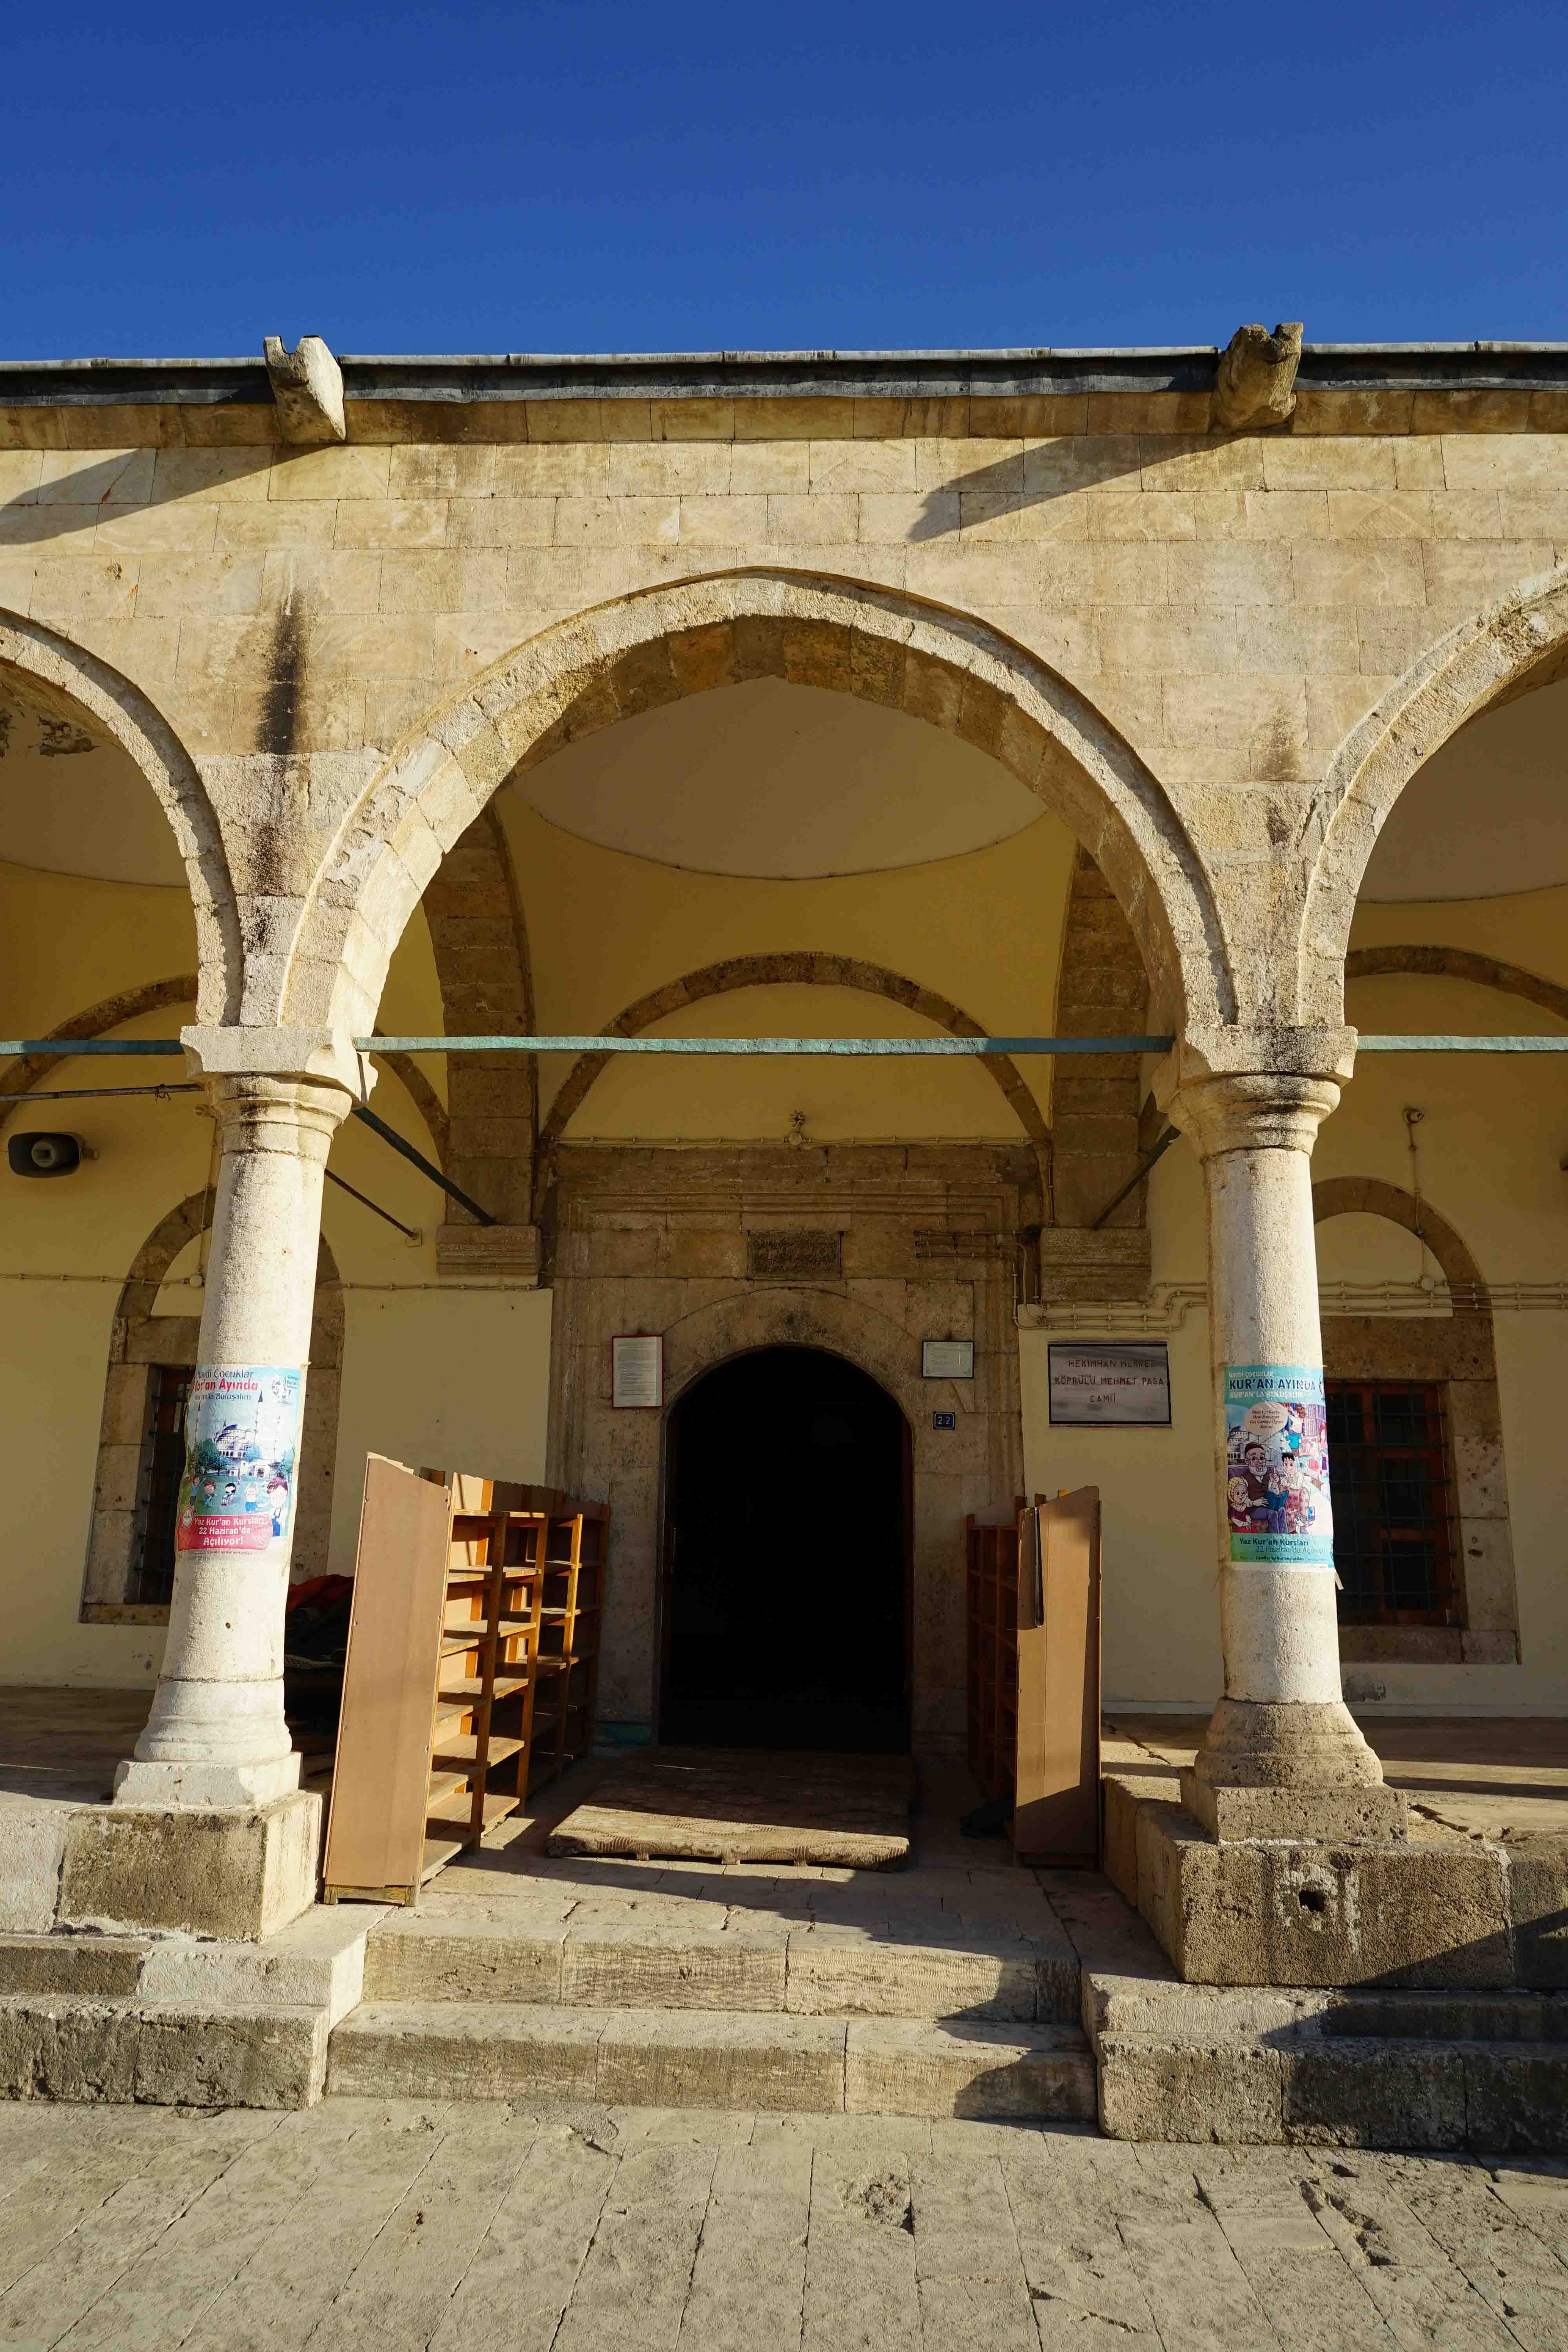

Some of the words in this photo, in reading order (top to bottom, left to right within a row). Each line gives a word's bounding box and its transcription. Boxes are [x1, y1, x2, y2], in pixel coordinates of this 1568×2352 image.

[1069, 1358, 1116, 1368] HEKİMHAN
[214, 1369, 254, 1380] Çocuklar
[219, 1378, 258, 1392] Ayında
[1054, 1375, 1096, 1385] KÖPRÜLÜ
[1101, 1377, 1136, 1385] MEHMET
[1142, 1377, 1164, 1387] PAŞA
[1230, 1379, 1273, 1390] KUR'AN
[1278, 1379, 1316, 1390] AYINDA
[216, 1392, 251, 1401] Buluşalım
[938, 1416, 950, 1425] 22
[209, 1526, 251, 1535] Haziran'da
[203, 1537, 244, 1547] Açılıyor!
